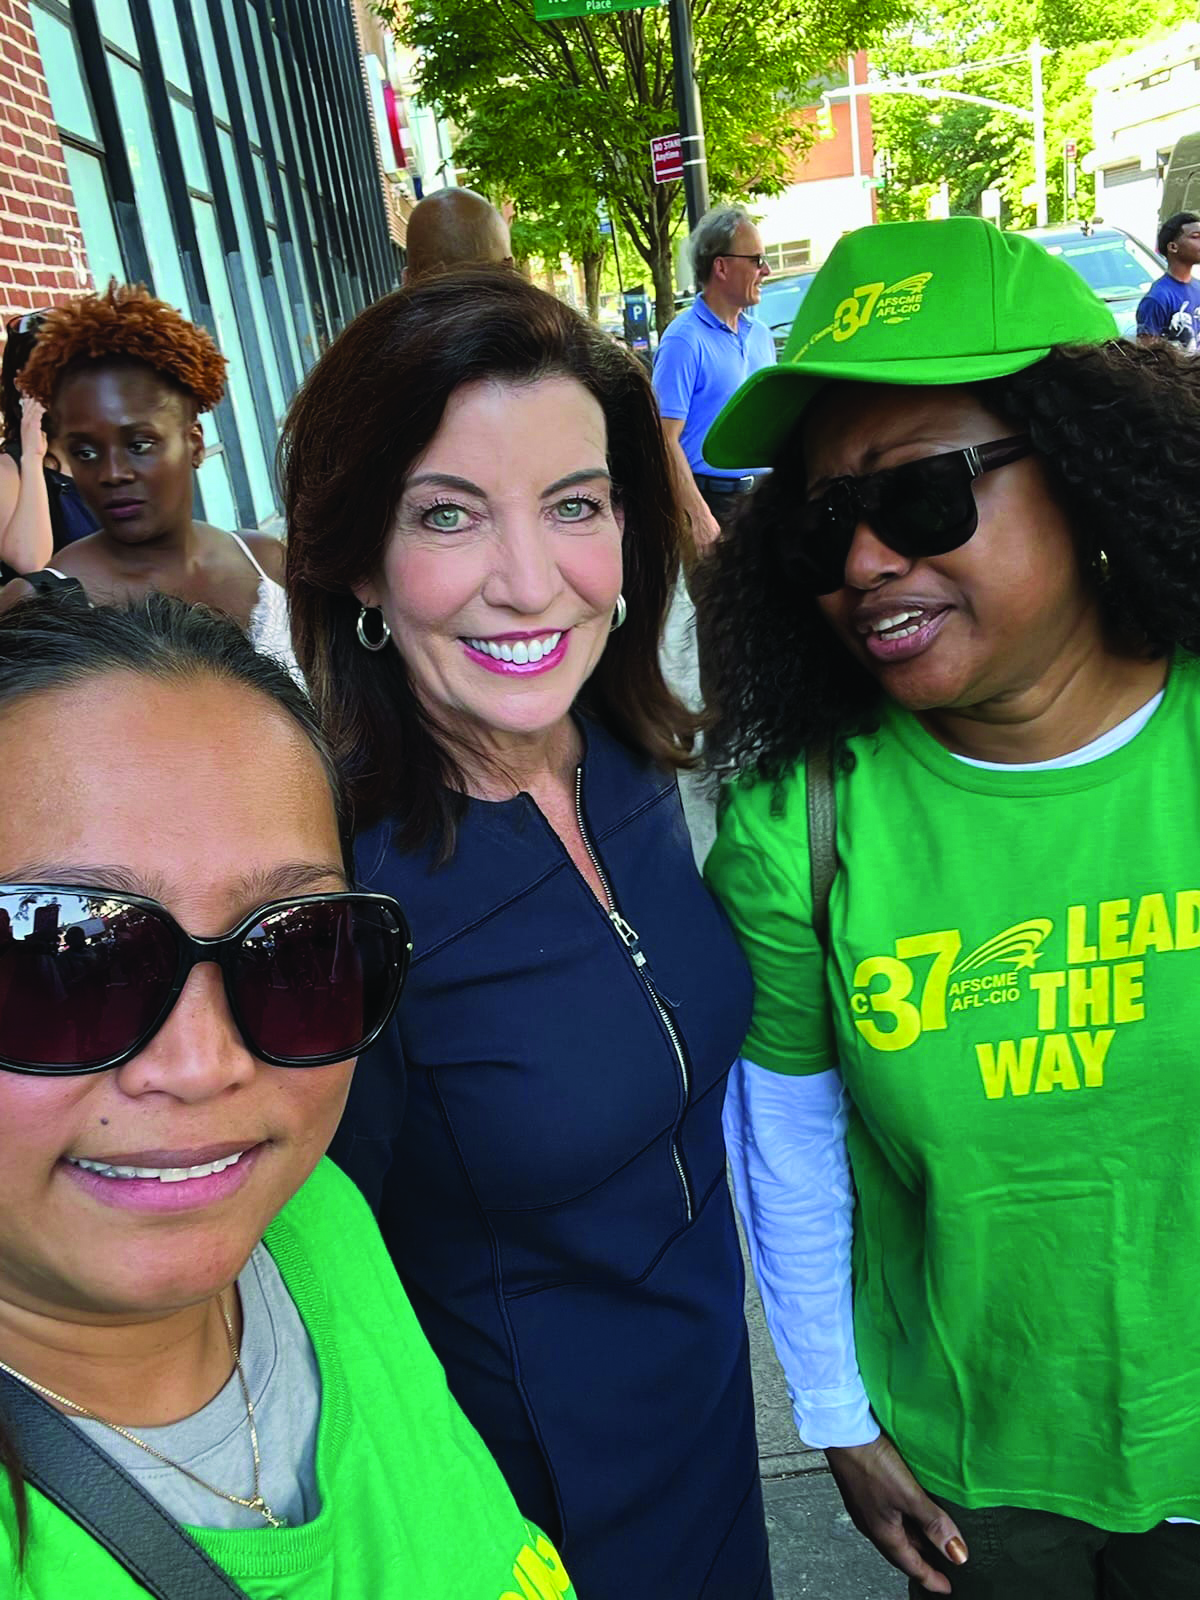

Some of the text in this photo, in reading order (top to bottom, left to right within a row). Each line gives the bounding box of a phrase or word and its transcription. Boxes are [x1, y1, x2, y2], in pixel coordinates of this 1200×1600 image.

[586, 0, 612, 11] Place
[633, 305, 643, 321] P
[876, 294, 923, 309] AFSCME
[876, 303, 921, 318] AFL-CIO
[1066, 889, 1200, 964] LEAD
[948, 971, 1018, 997] AFSCME
[1029, 960, 1146, 1031] THE
[951, 988, 1020, 1012] AFL-CIO
[975, 1028, 1117, 1100] WAY
